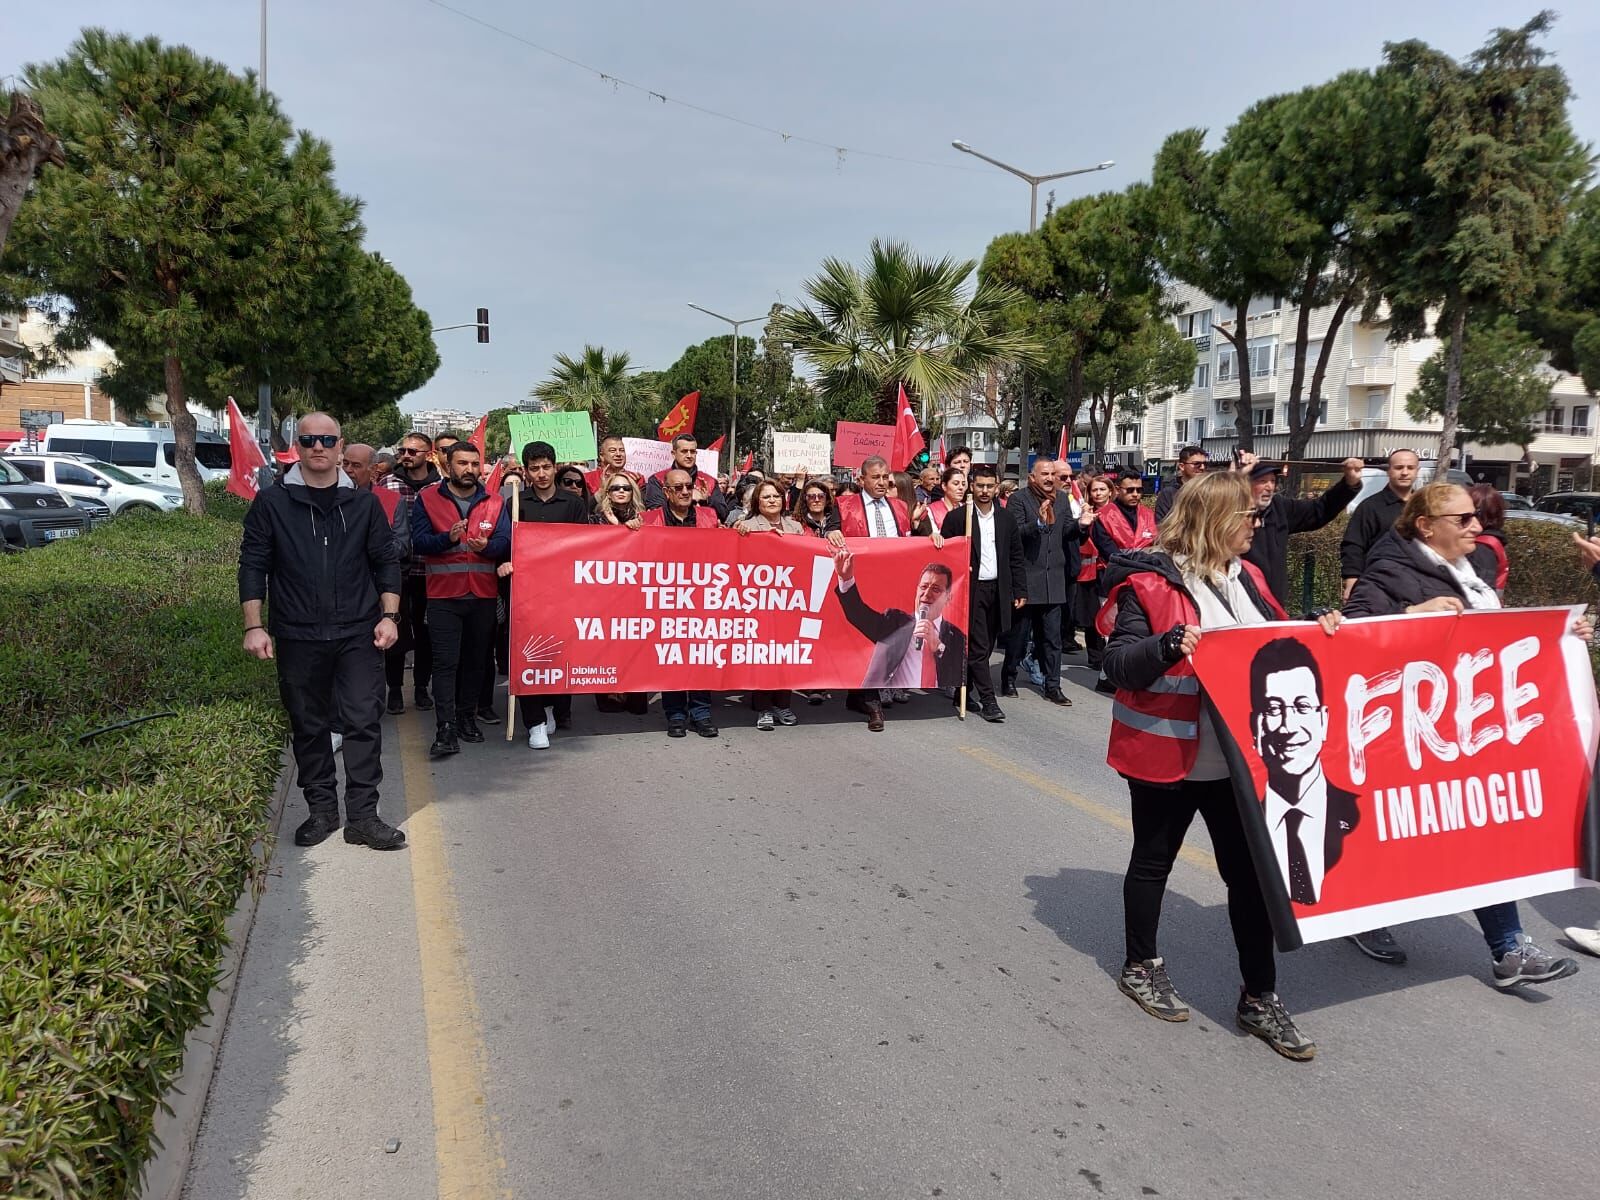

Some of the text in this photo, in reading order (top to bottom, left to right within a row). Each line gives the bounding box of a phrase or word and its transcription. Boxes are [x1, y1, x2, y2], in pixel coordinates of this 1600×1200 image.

[574, 560, 795, 592] KURTULUŞ YOK
[641, 586, 808, 614] TEK BAŞINA
[574, 617, 759, 640] YA HEP BERABER
[654, 639, 813, 669] YA HİÇ BİRİMİZ
[521, 668, 564, 685] CHP
[570, 676, 618, 687] BAŞKANLIĞI
[571, 665, 617, 677] DİDİM İLÇE
[1344, 636, 1545, 787] FREE
[1373, 768, 1543, 842] IMAMOGLU
